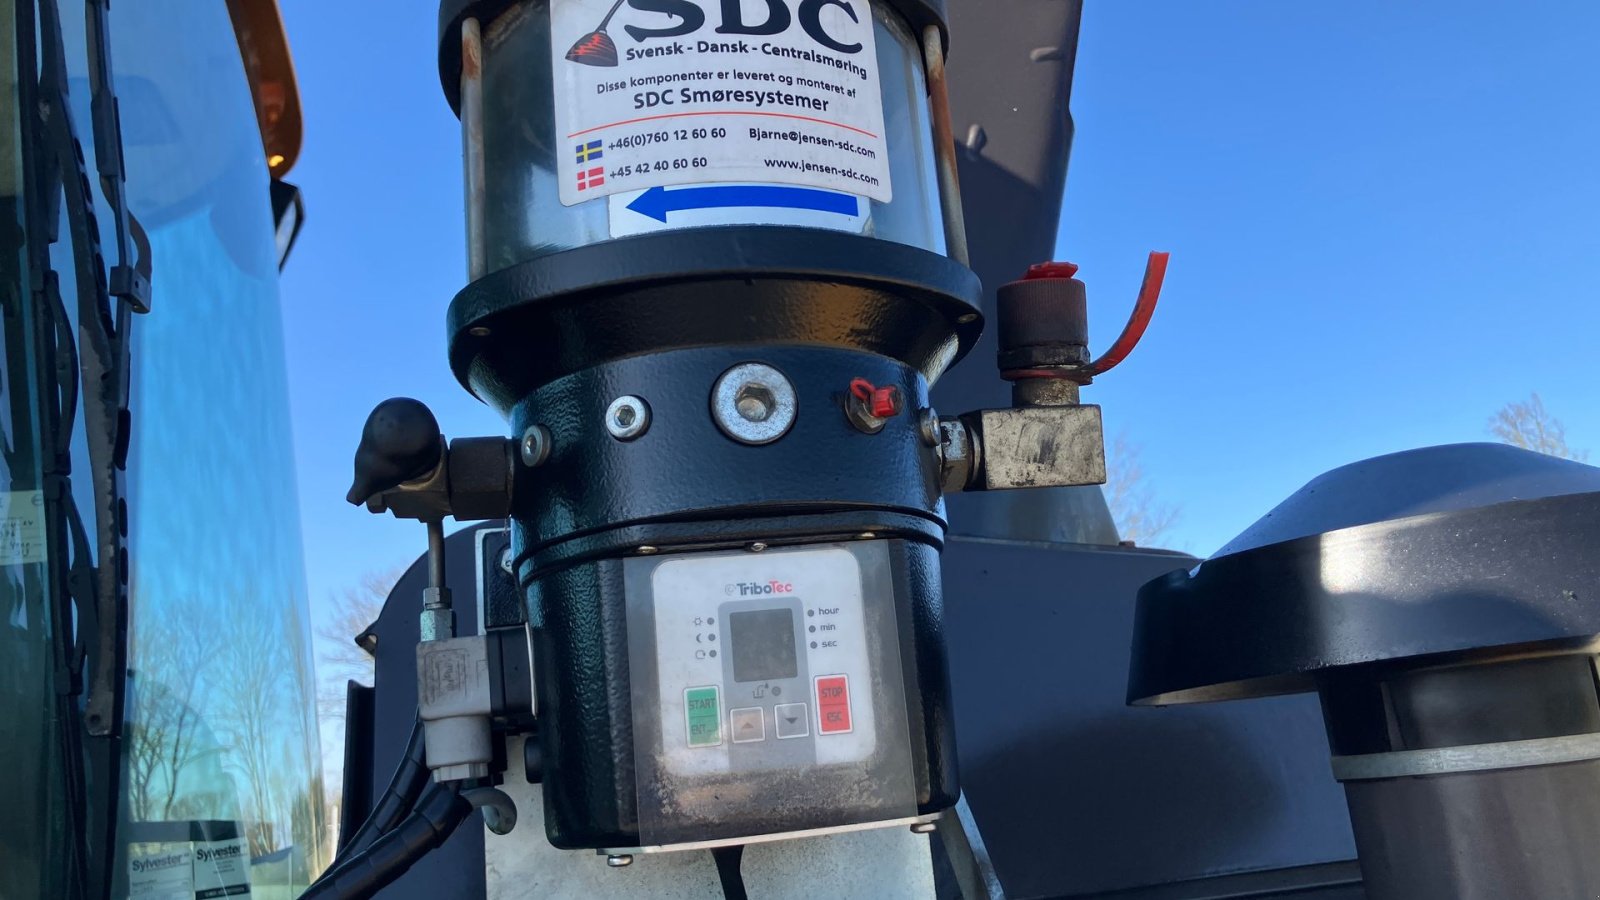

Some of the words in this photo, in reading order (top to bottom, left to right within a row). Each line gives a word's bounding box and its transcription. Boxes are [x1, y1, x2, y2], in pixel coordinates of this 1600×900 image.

[624, 0, 863, 54] SDC
[626, 42, 684, 61] Svensk
[697, 40, 748, 53] Dansk
[761, 42, 867, 80] Centralsmøring
[597, 81, 626, 94] Disse
[630, 71, 713, 88] komponenter
[717, 70, 730, 80] er
[733, 69, 775, 82] leveret
[778, 74, 793, 86] og
[796, 77, 845, 95] monteret
[847, 88, 856, 99] af
[634, 89, 674, 109] SDC
[680, 87, 829, 112] Smøresystemer
[608, 131, 669, 150] +46(0)760
[673, 129, 688, 140] 12
[692, 128, 707, 139] 60
[711, 127, 726, 138] 60
[749, 128, 876, 159] Bjarne@jensen-sdc.com
[609, 166, 632, 179] +45
[635, 163, 650, 174] 42
[653, 160, 669, 171] 40
[673, 158, 688, 170] 60
[692, 157, 708, 168] 60
[764, 159, 879, 186] www.jensen-sdc.com
[737, 581, 793, 595] TriboTec
[818, 607, 840, 616] hour
[820, 624, 836, 632] min
[821, 640, 838, 648] sec
[822, 686, 843, 698] STOP
[688, 698, 716, 710] START
[132, 853, 182, 872] Sylvester
[196, 844, 241, 862] Sylvester
